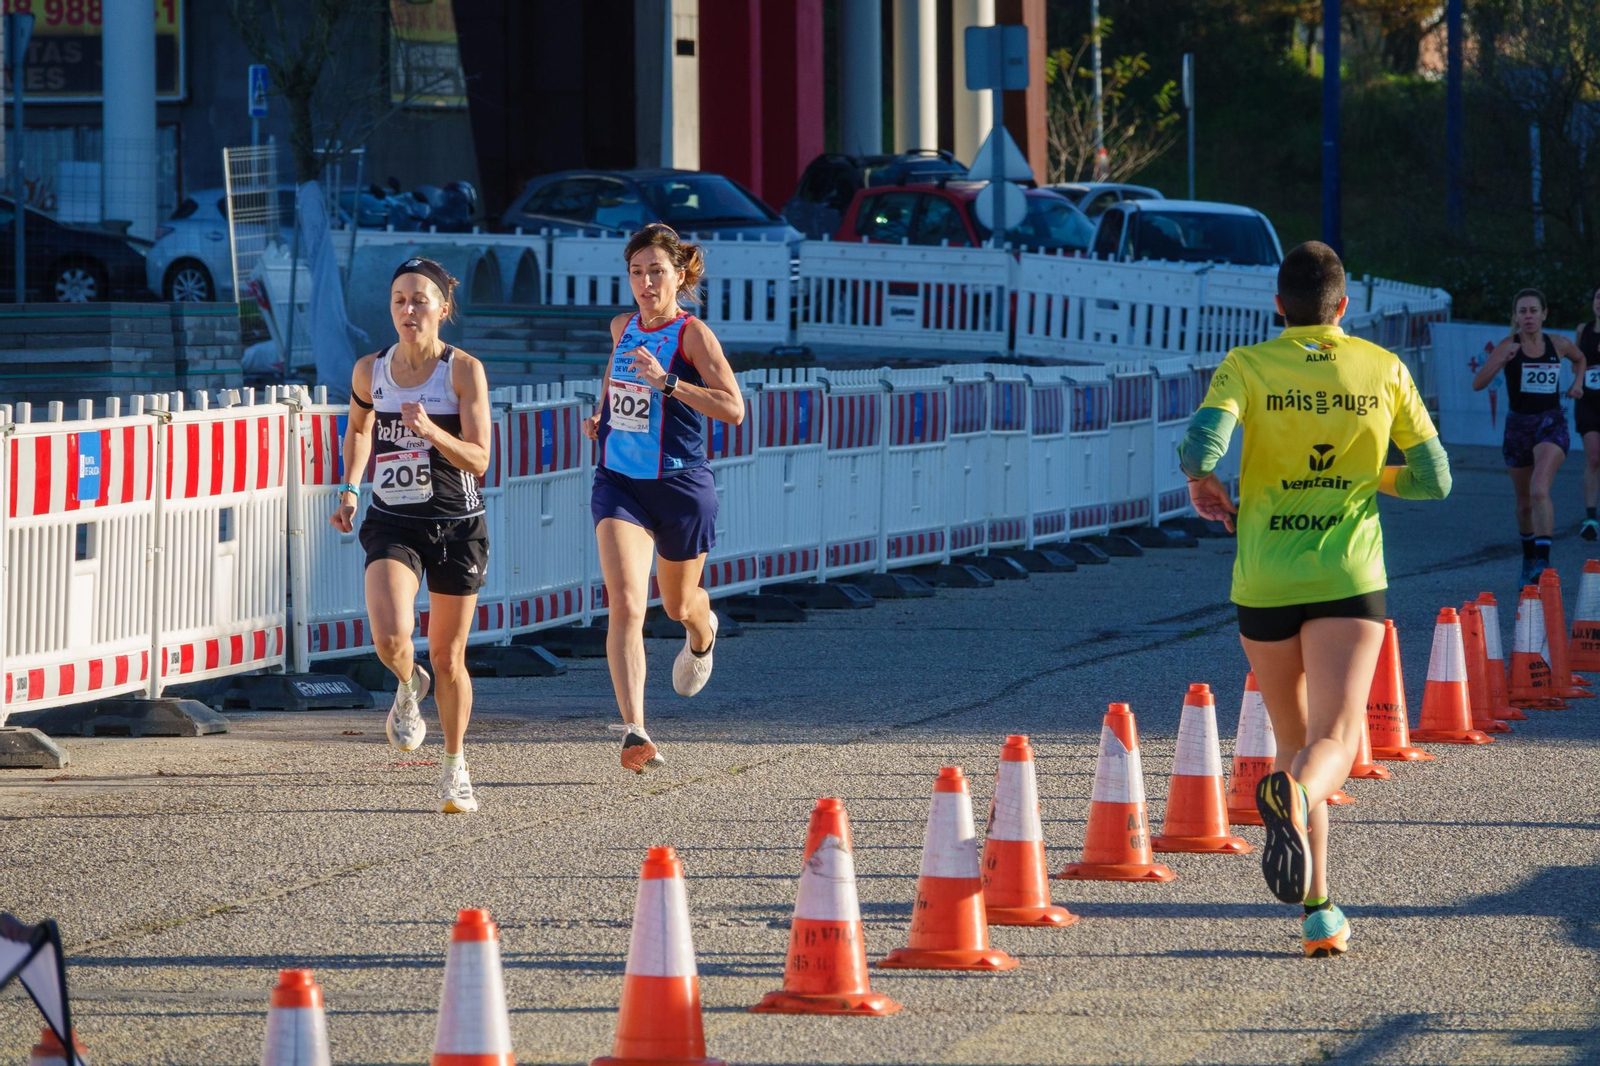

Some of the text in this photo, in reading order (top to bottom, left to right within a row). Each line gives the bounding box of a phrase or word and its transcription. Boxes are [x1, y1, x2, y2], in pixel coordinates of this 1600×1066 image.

[1306, 354, 1336, 362] ALMU
[1526, 372, 1556, 384] 203
[612, 393, 650, 419] 202
[1266, 389, 1379, 416] máis que auga
[380, 464, 430, 489] 205
[1281, 476, 1352, 490] ventair
[1270, 514, 1345, 530] EKOKA
